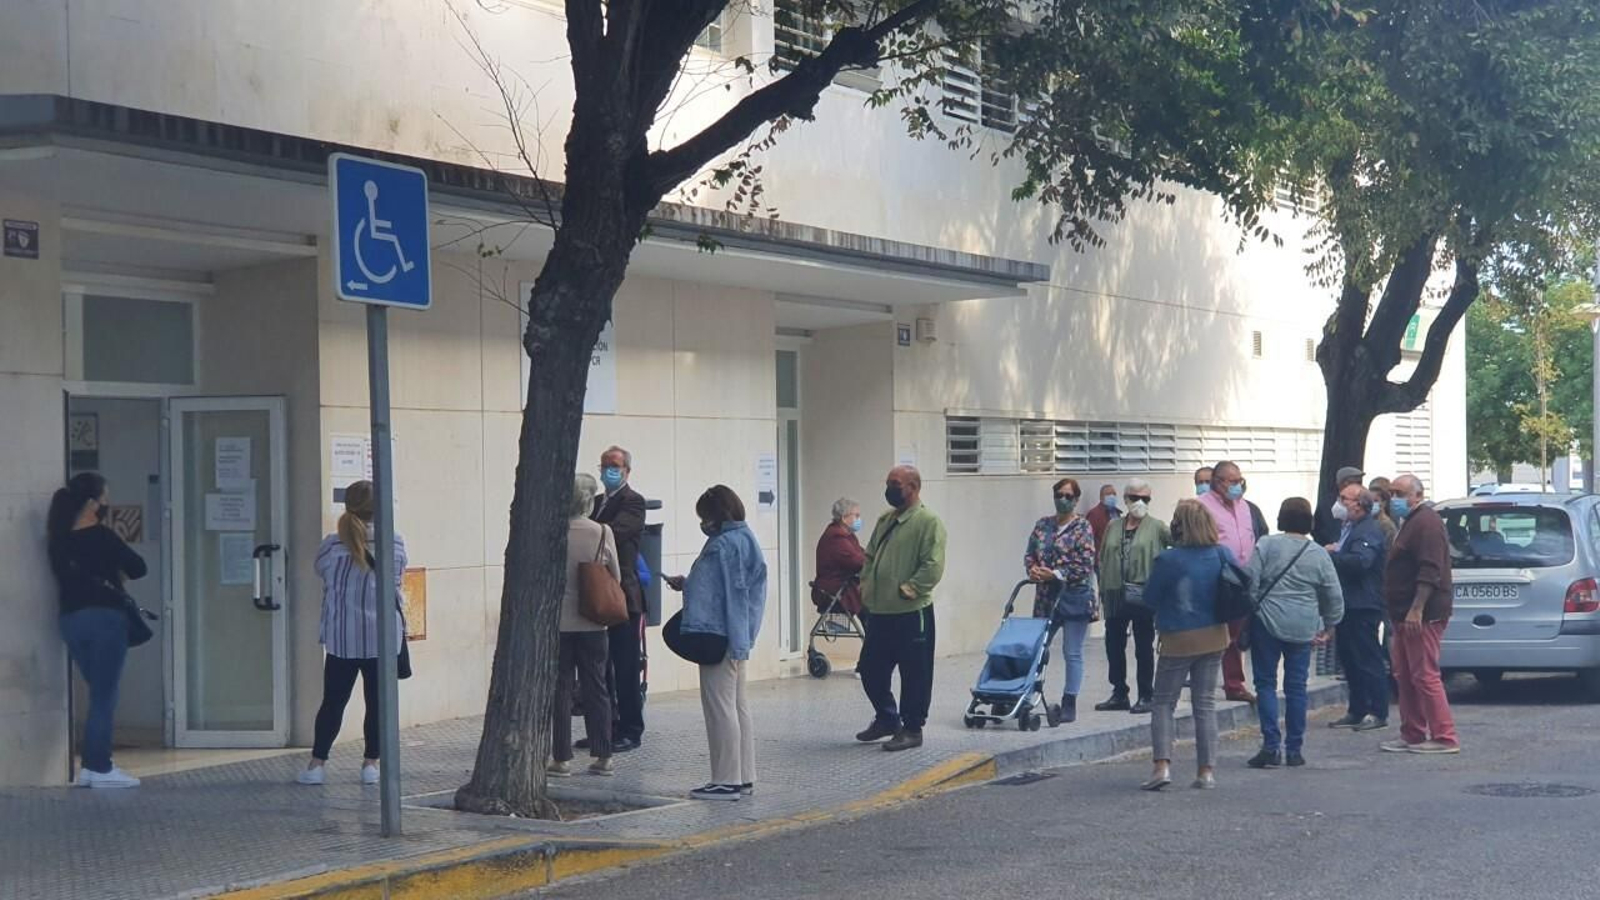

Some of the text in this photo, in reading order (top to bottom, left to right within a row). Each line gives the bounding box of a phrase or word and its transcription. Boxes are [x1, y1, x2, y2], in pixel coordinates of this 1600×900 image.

[591, 355, 601, 366] CR
[1455, 585, 1517, 598] CA 0560 BS
